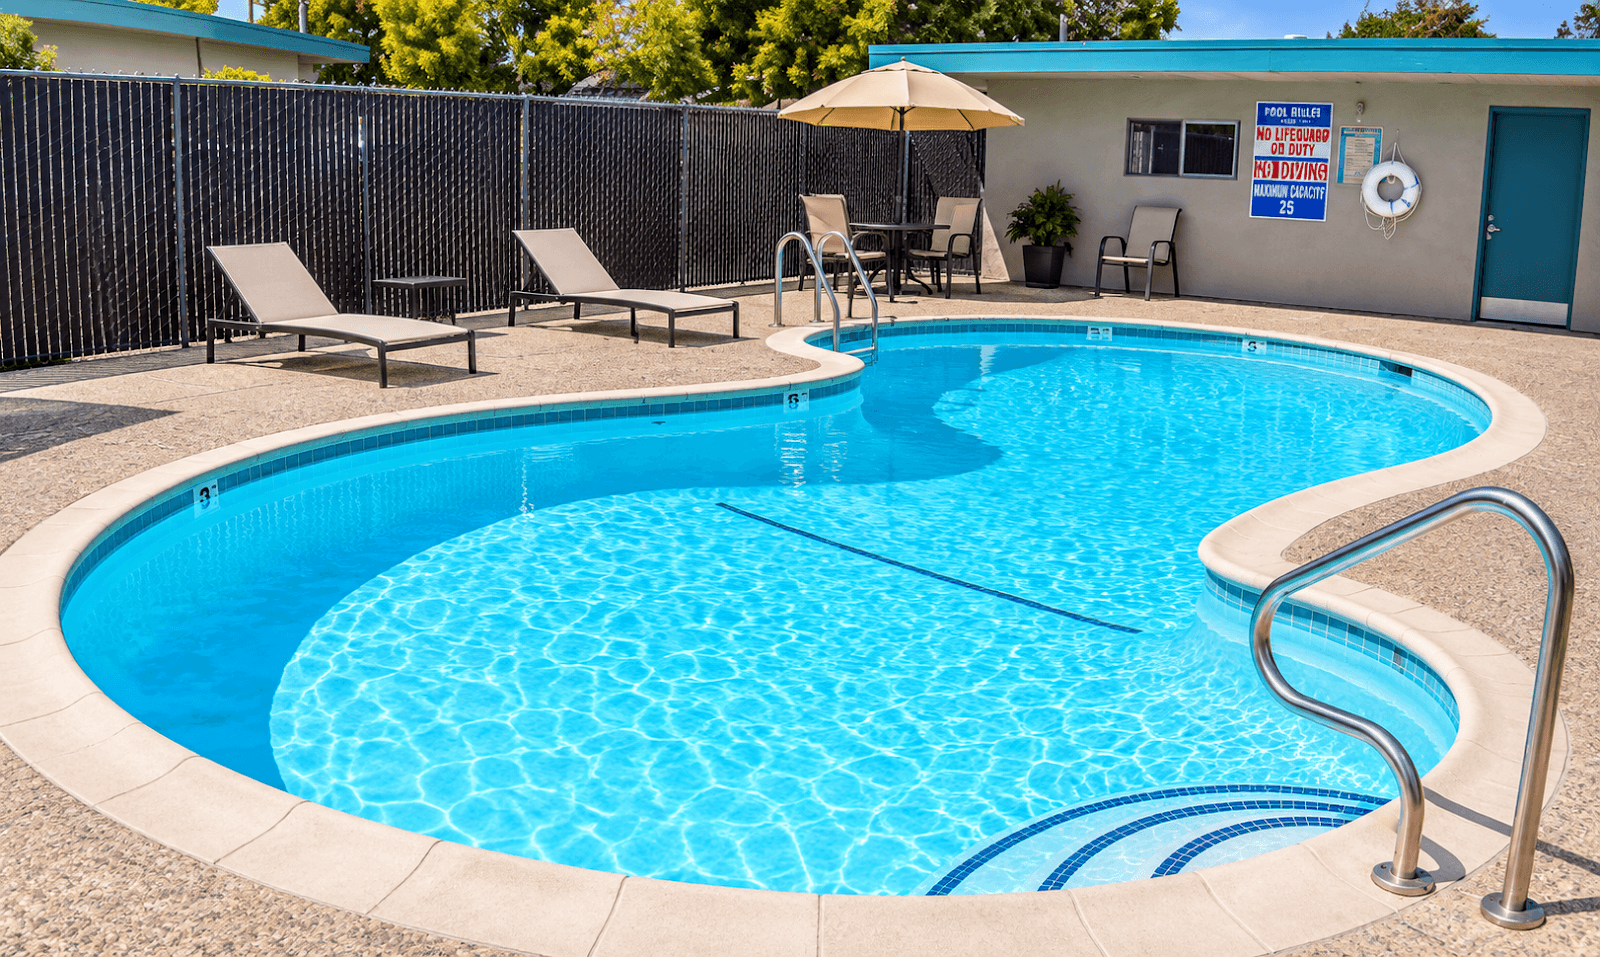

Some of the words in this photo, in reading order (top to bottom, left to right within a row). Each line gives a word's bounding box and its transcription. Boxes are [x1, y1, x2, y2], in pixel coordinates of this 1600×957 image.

[1256, 126, 1272, 141] NO
[1288, 142, 1316, 156] DUTY
[1279, 199, 1294, 215] 25
